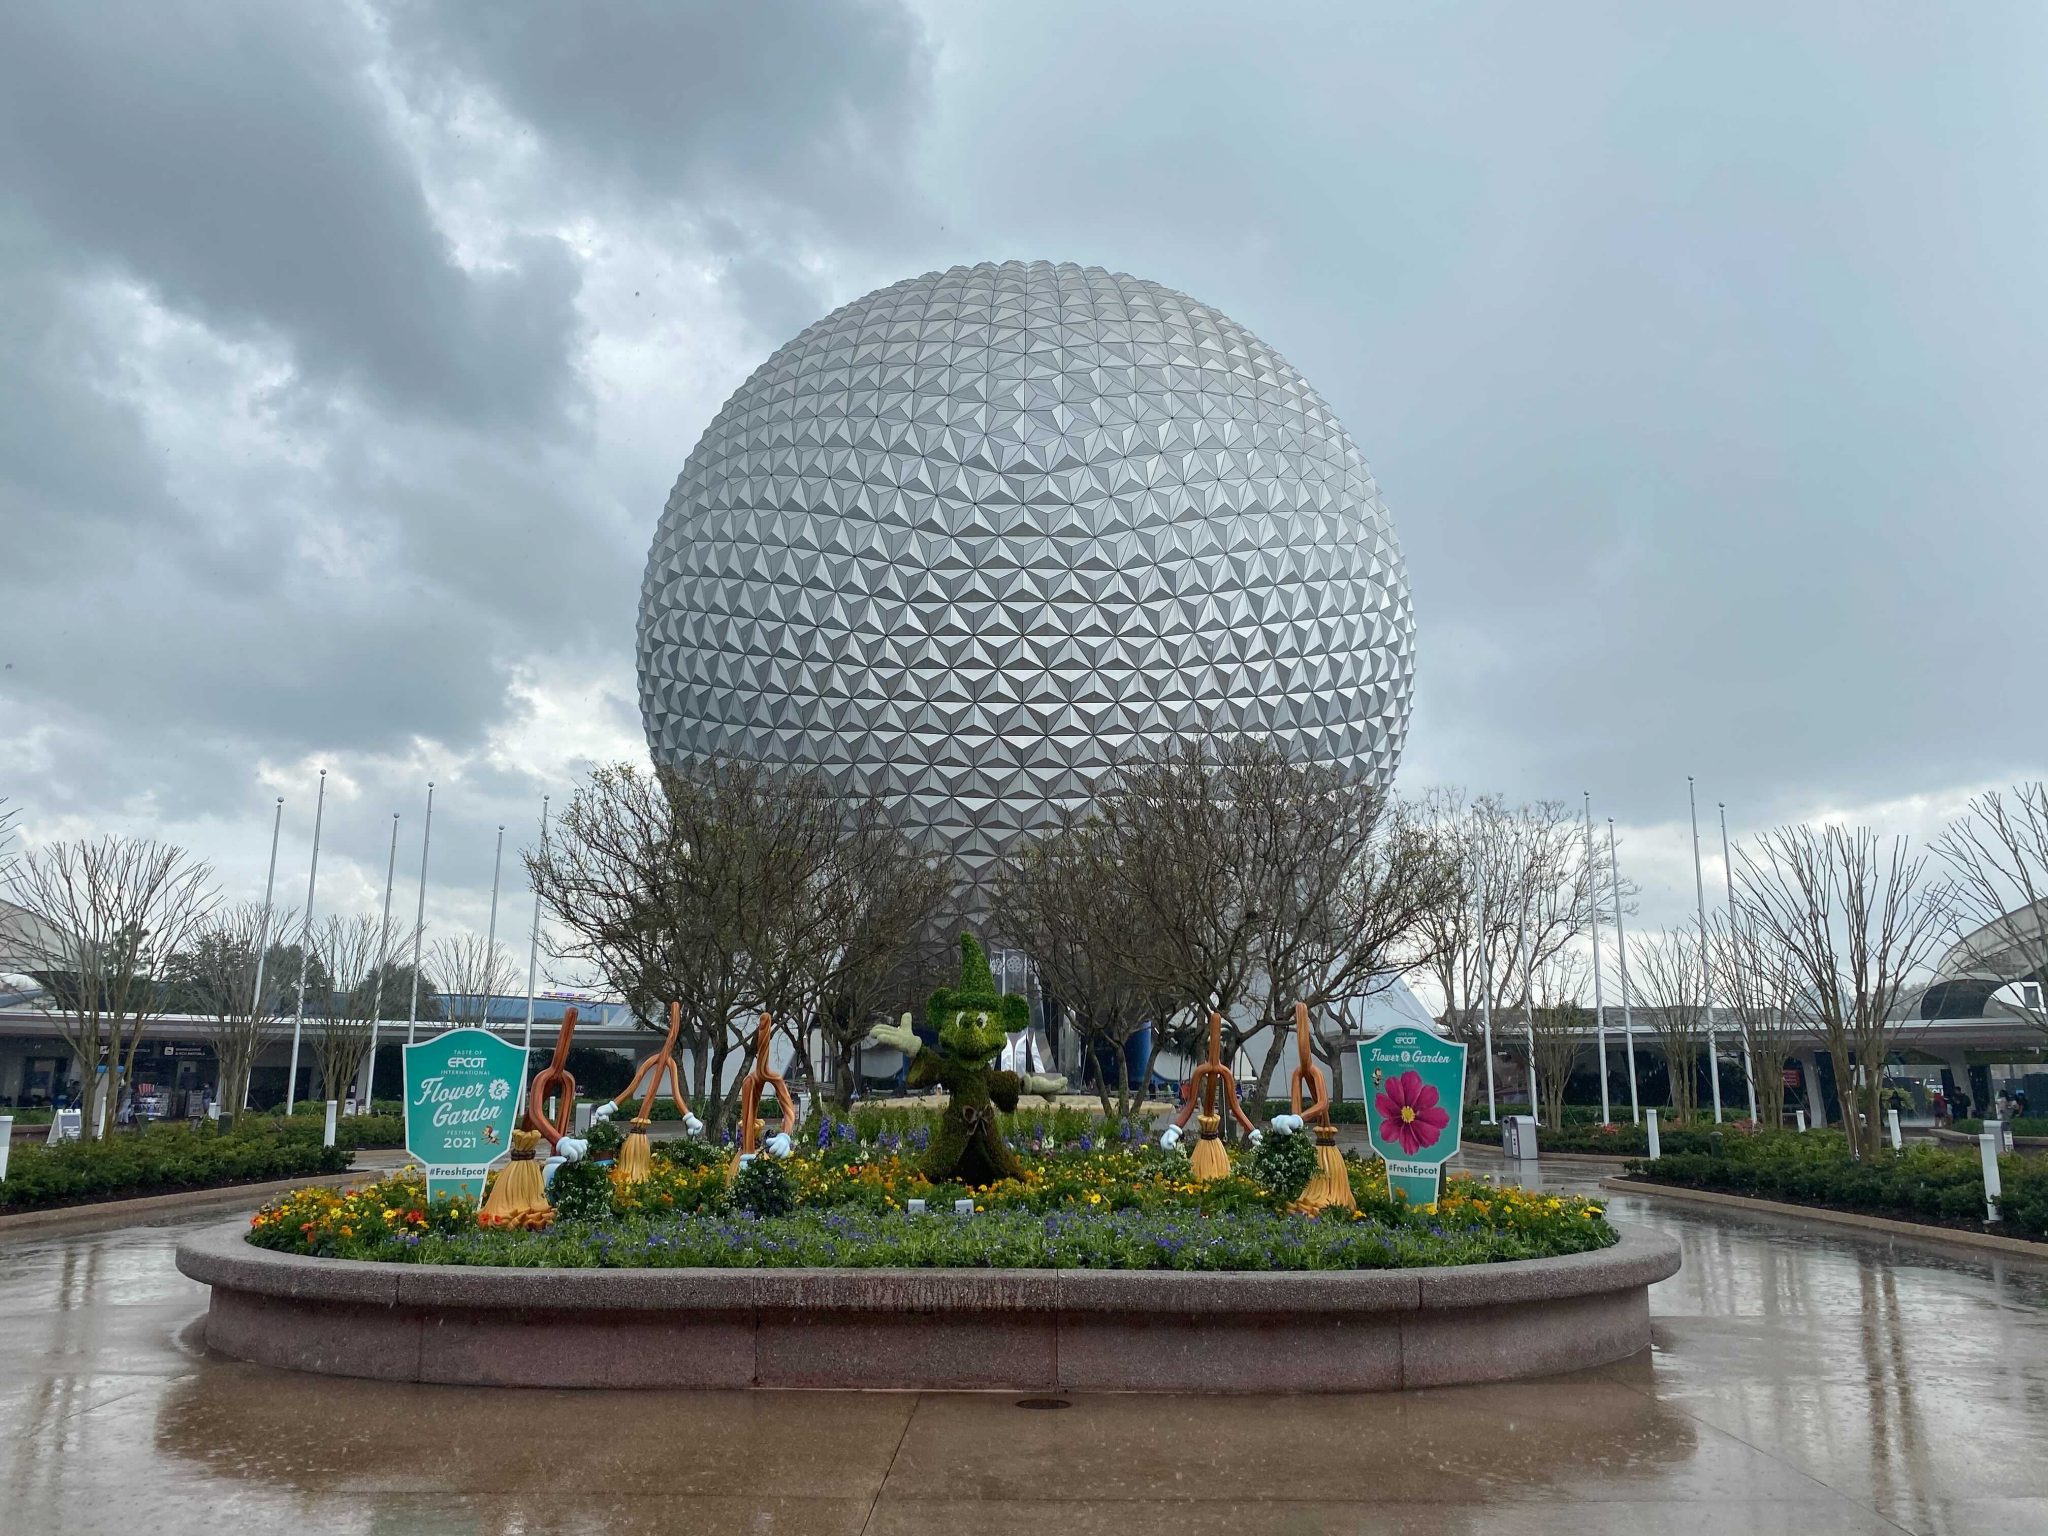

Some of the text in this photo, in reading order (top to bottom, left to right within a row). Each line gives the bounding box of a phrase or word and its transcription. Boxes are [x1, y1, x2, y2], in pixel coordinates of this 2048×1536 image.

[1370, 1048, 1399, 1062] Flower
[1412, 1050, 1451, 1063] Garden
[448, 1057, 487, 1068] EPCOT
[413, 1077, 485, 1106] Flower
[432, 1098, 502, 1127] Garden
[443, 1137, 477, 1149] 2021
[429, 1167, 486, 1177] #FreshEpcot
[1389, 1164, 1437, 1176] #FreshEpcot
